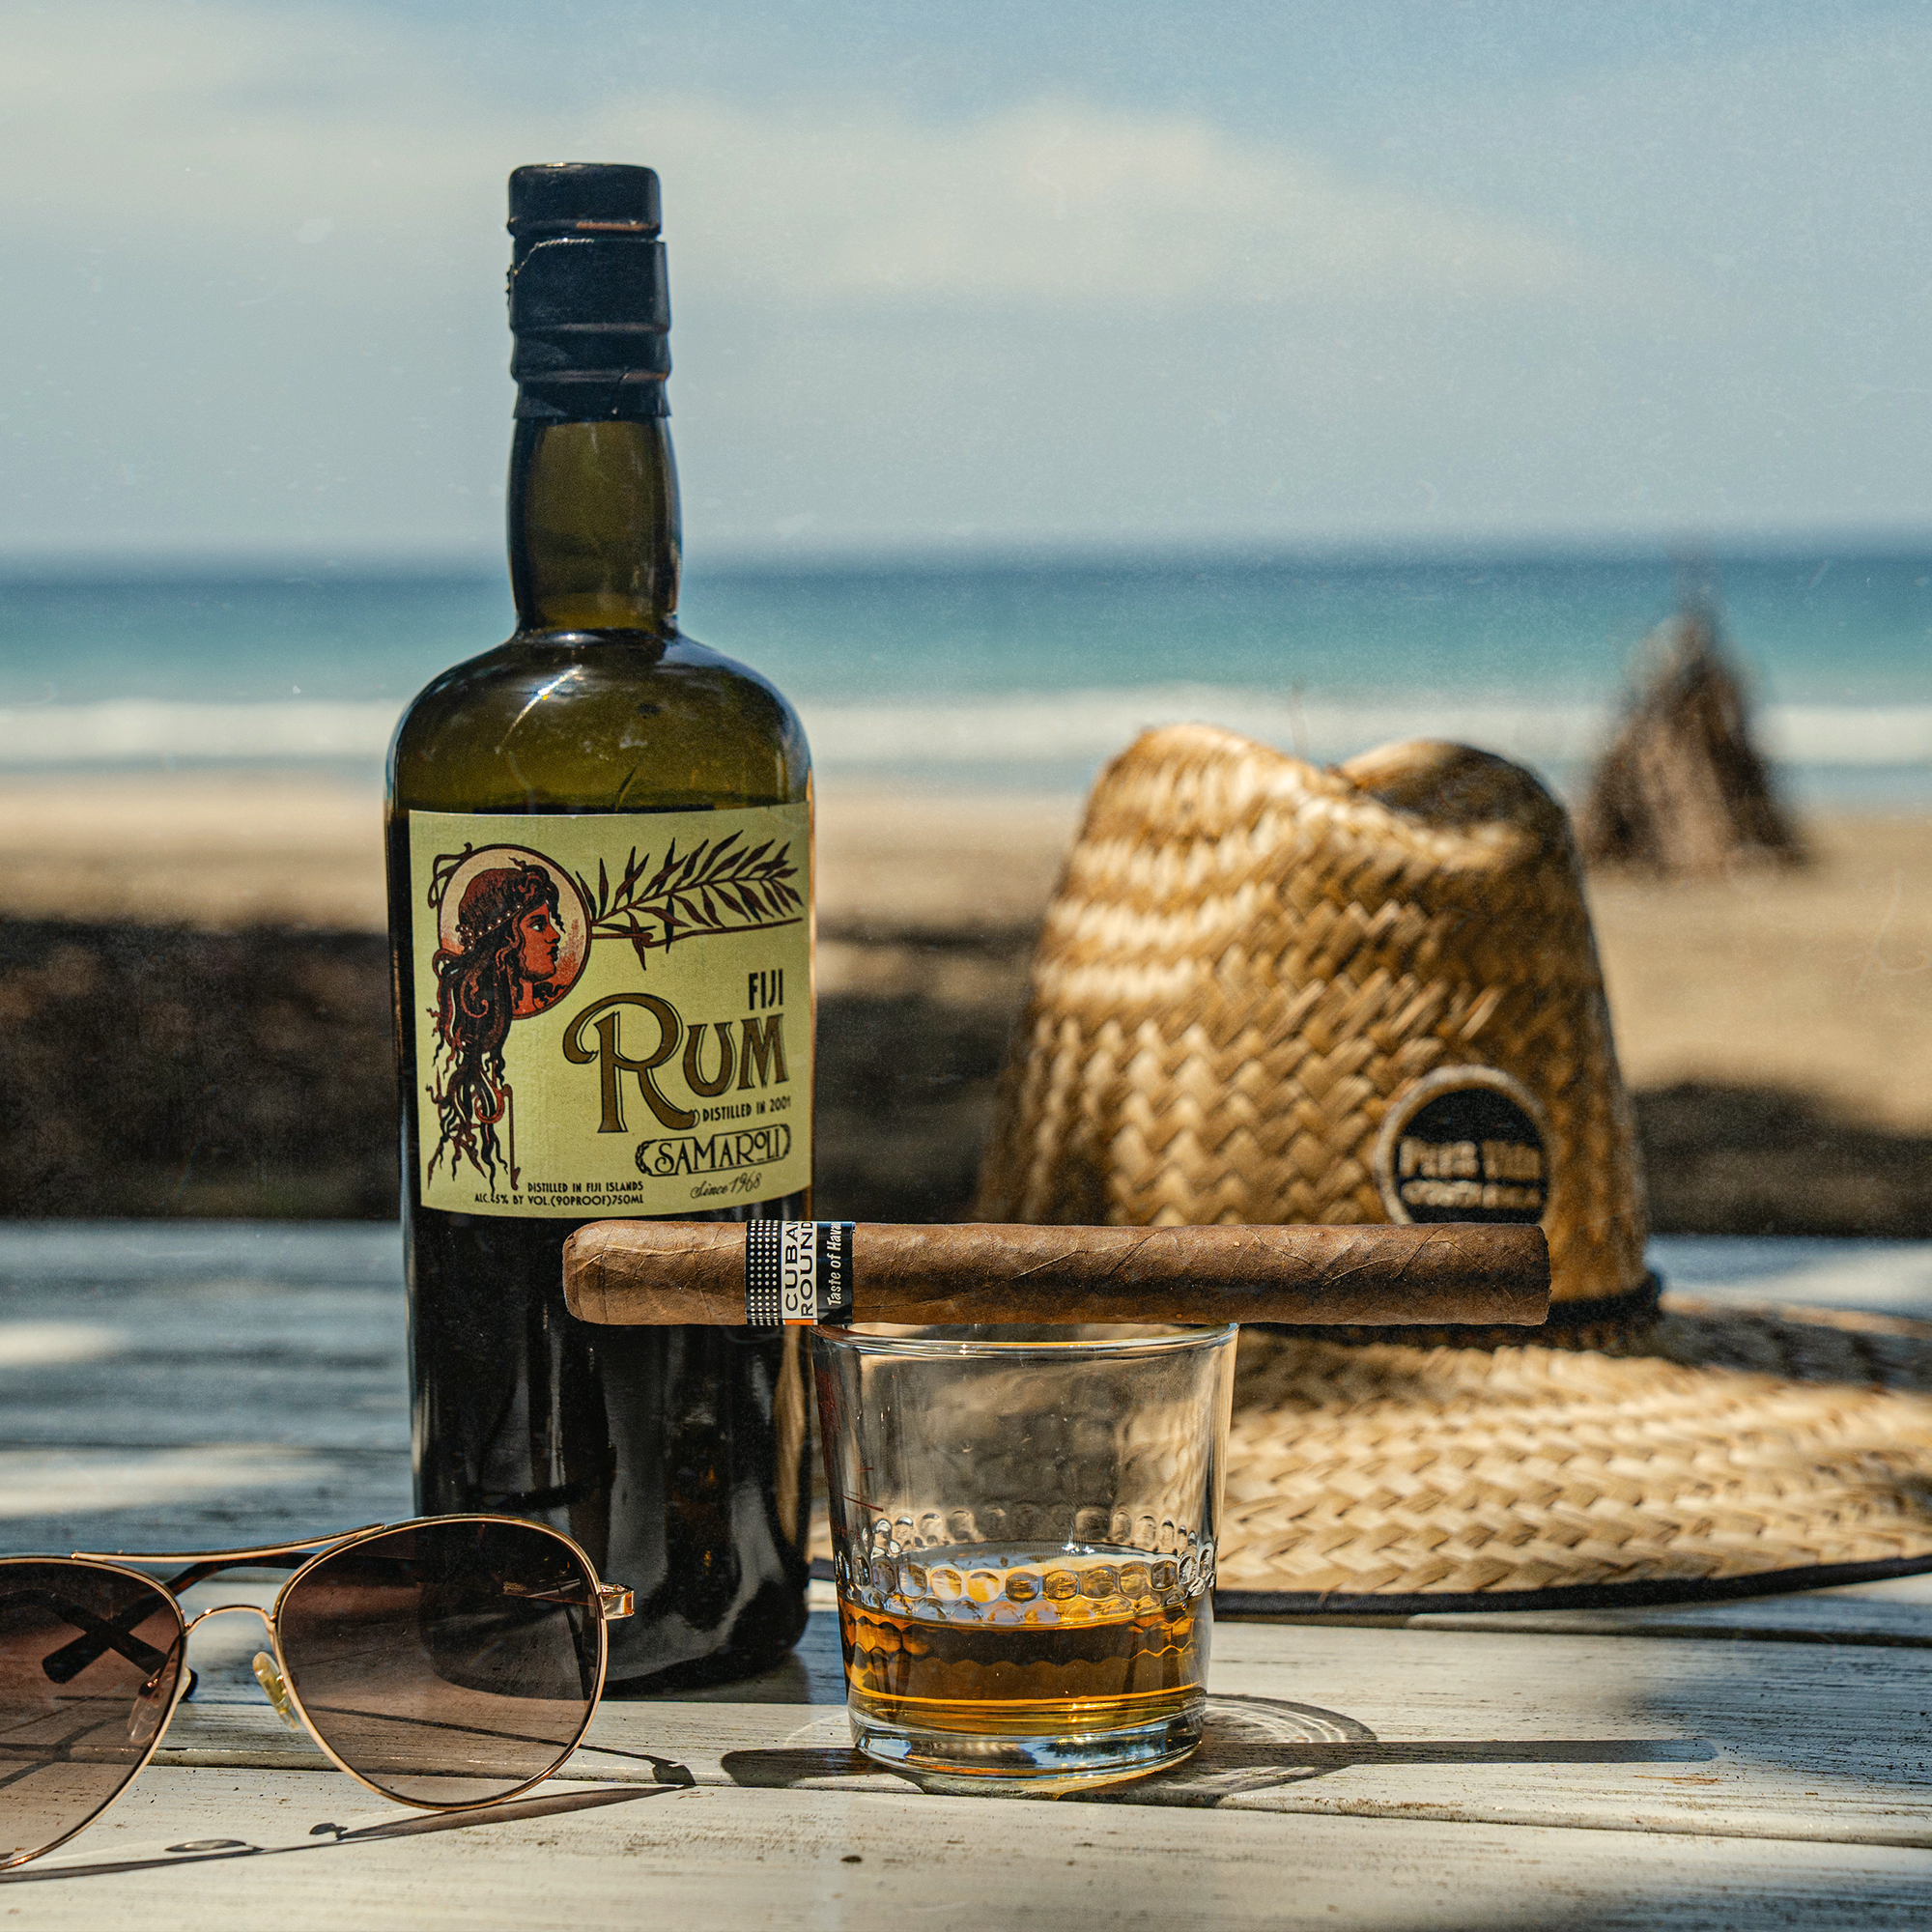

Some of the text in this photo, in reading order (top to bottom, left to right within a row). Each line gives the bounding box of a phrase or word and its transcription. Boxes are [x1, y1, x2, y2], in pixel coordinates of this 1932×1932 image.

[749, 968, 783, 1010] FIJI
[562, 992, 789, 1133] RUM
[702, 1095, 791, 1122] DISTILLED IN 2001
[654, 1127, 781, 1176] SAMAROLI
[513, 1194, 524, 1206] BY
[527, 1180, 644, 1193] DISTILLED IN FIJI ISLANDS
[690, 1171, 762, 1200] Since 1968
[826, 1222, 842, 1306] Taste of Hava
